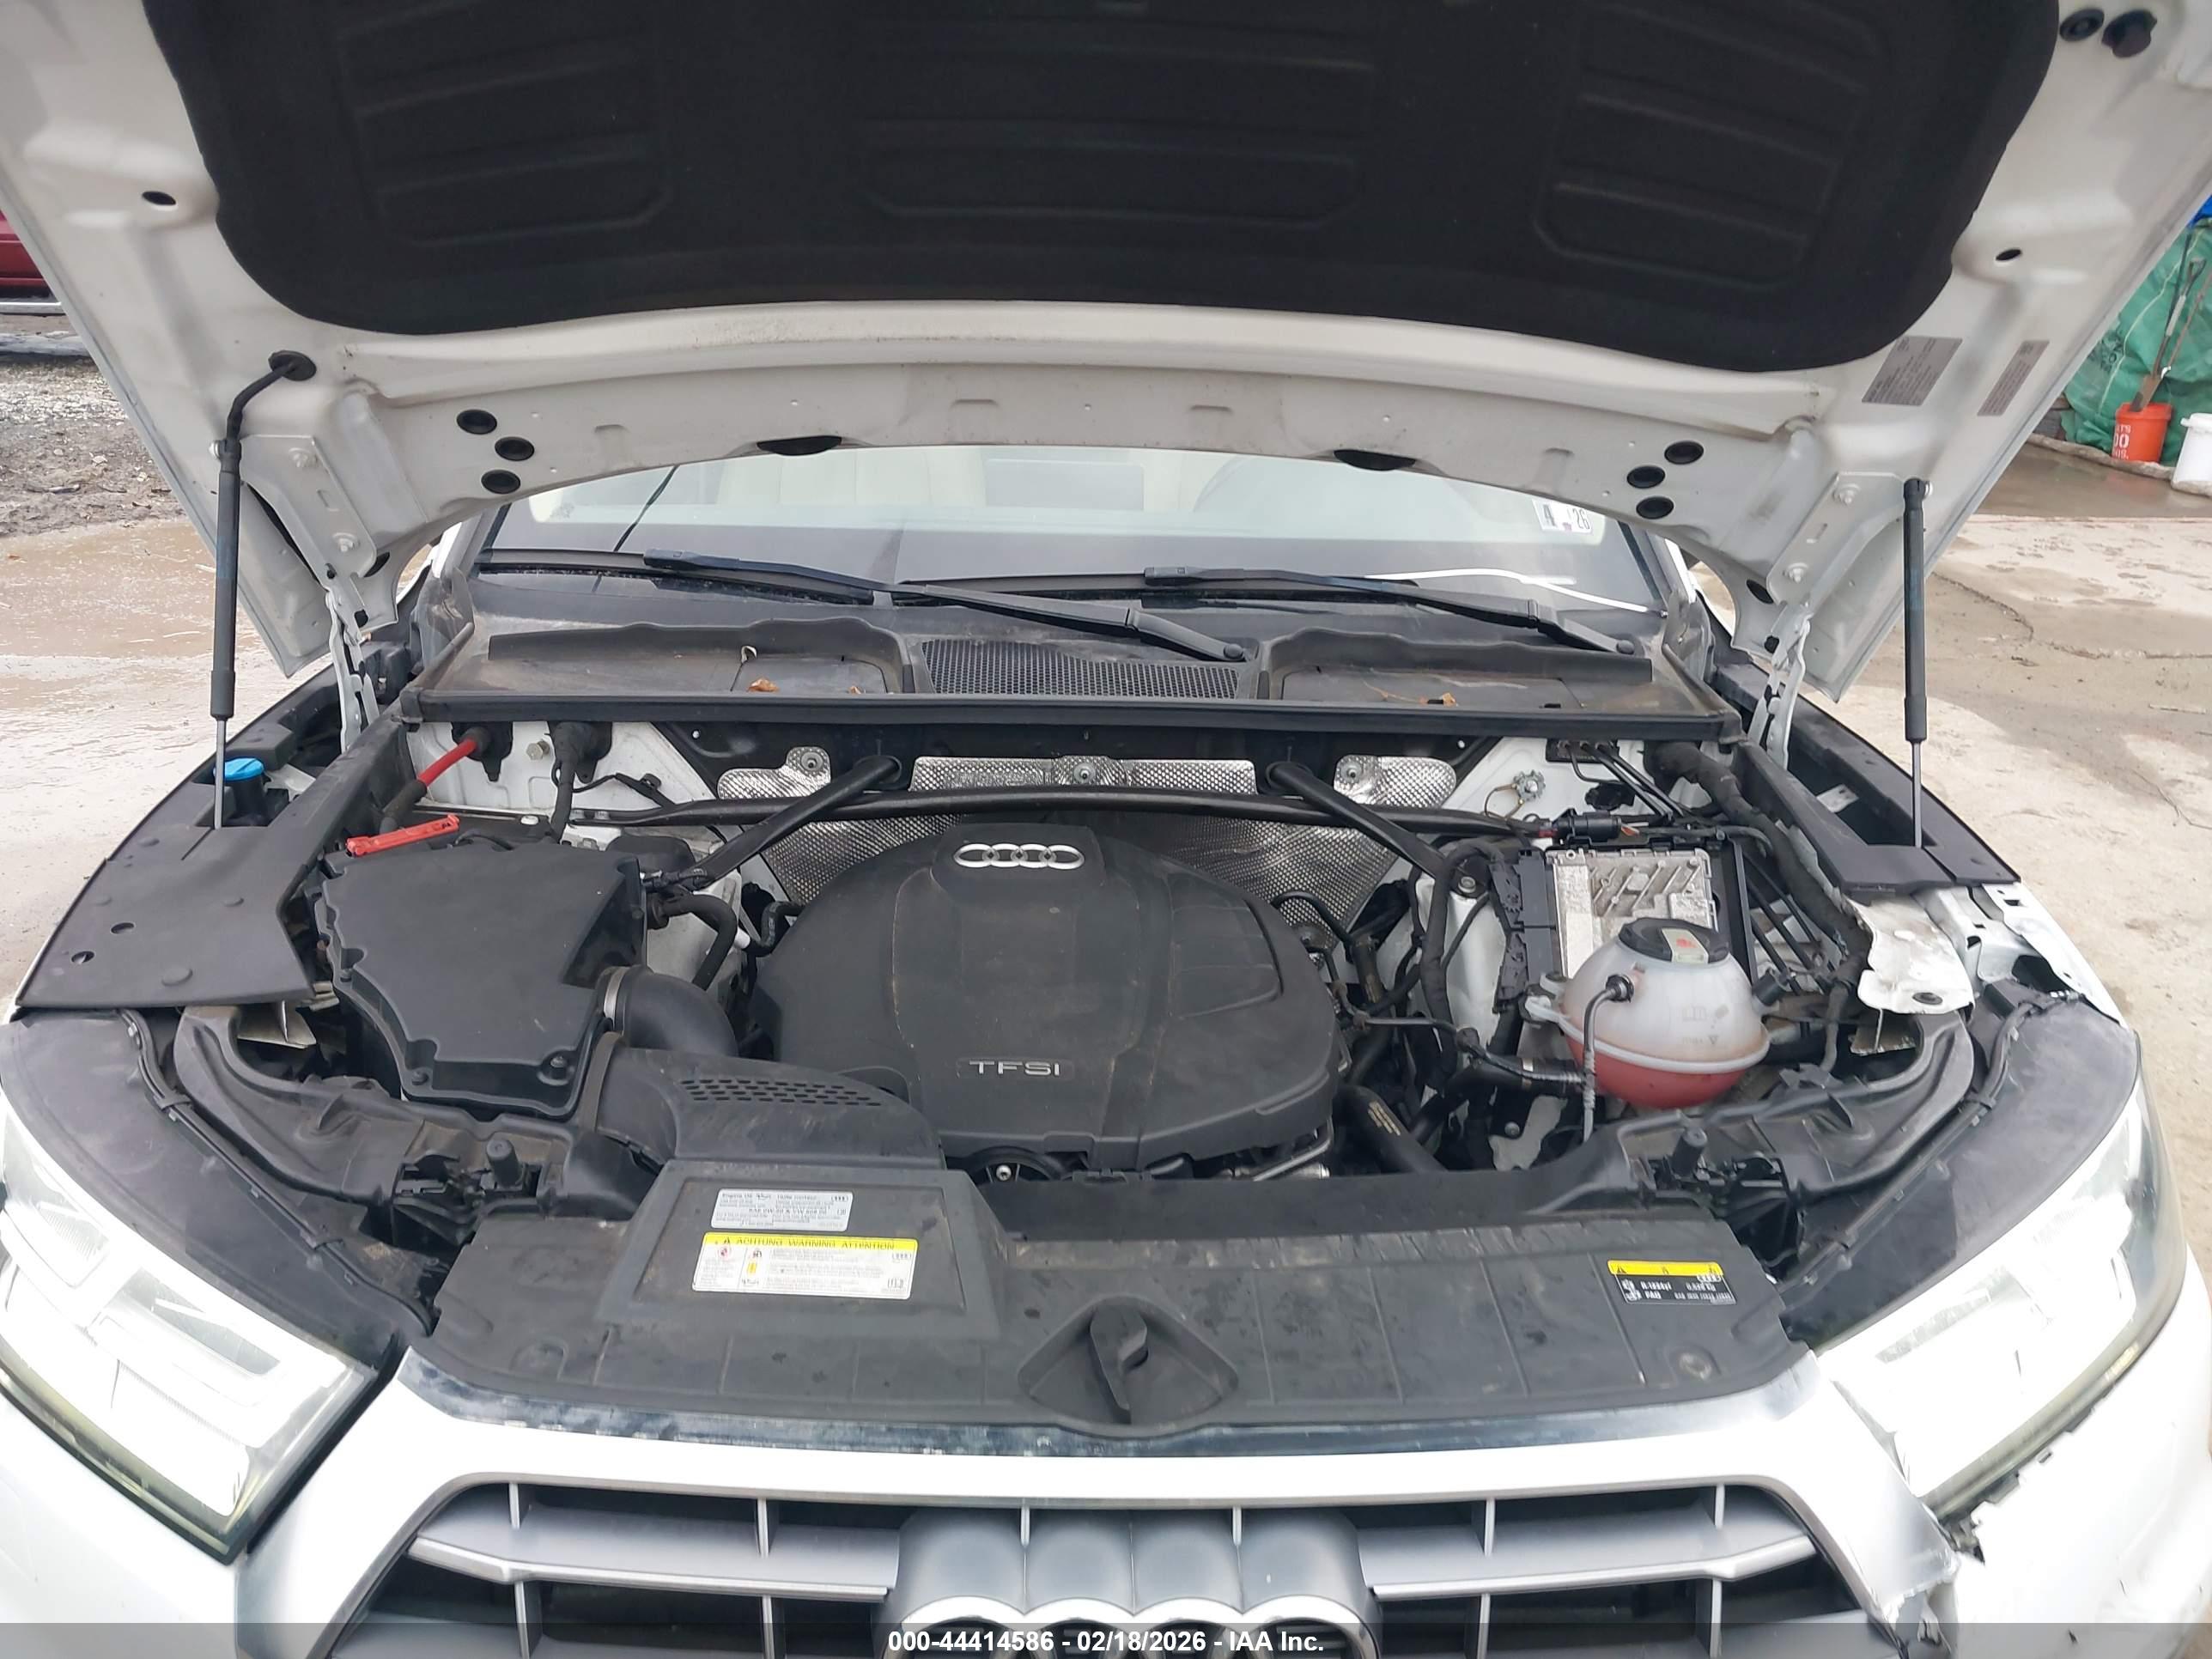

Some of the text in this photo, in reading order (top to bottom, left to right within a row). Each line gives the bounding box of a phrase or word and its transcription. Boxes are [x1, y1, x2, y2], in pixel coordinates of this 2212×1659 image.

[969, 1060, 1060, 1076] TFSI
[735, 1237, 895, 1250] ACHTUNG WARNING ATTENTION
